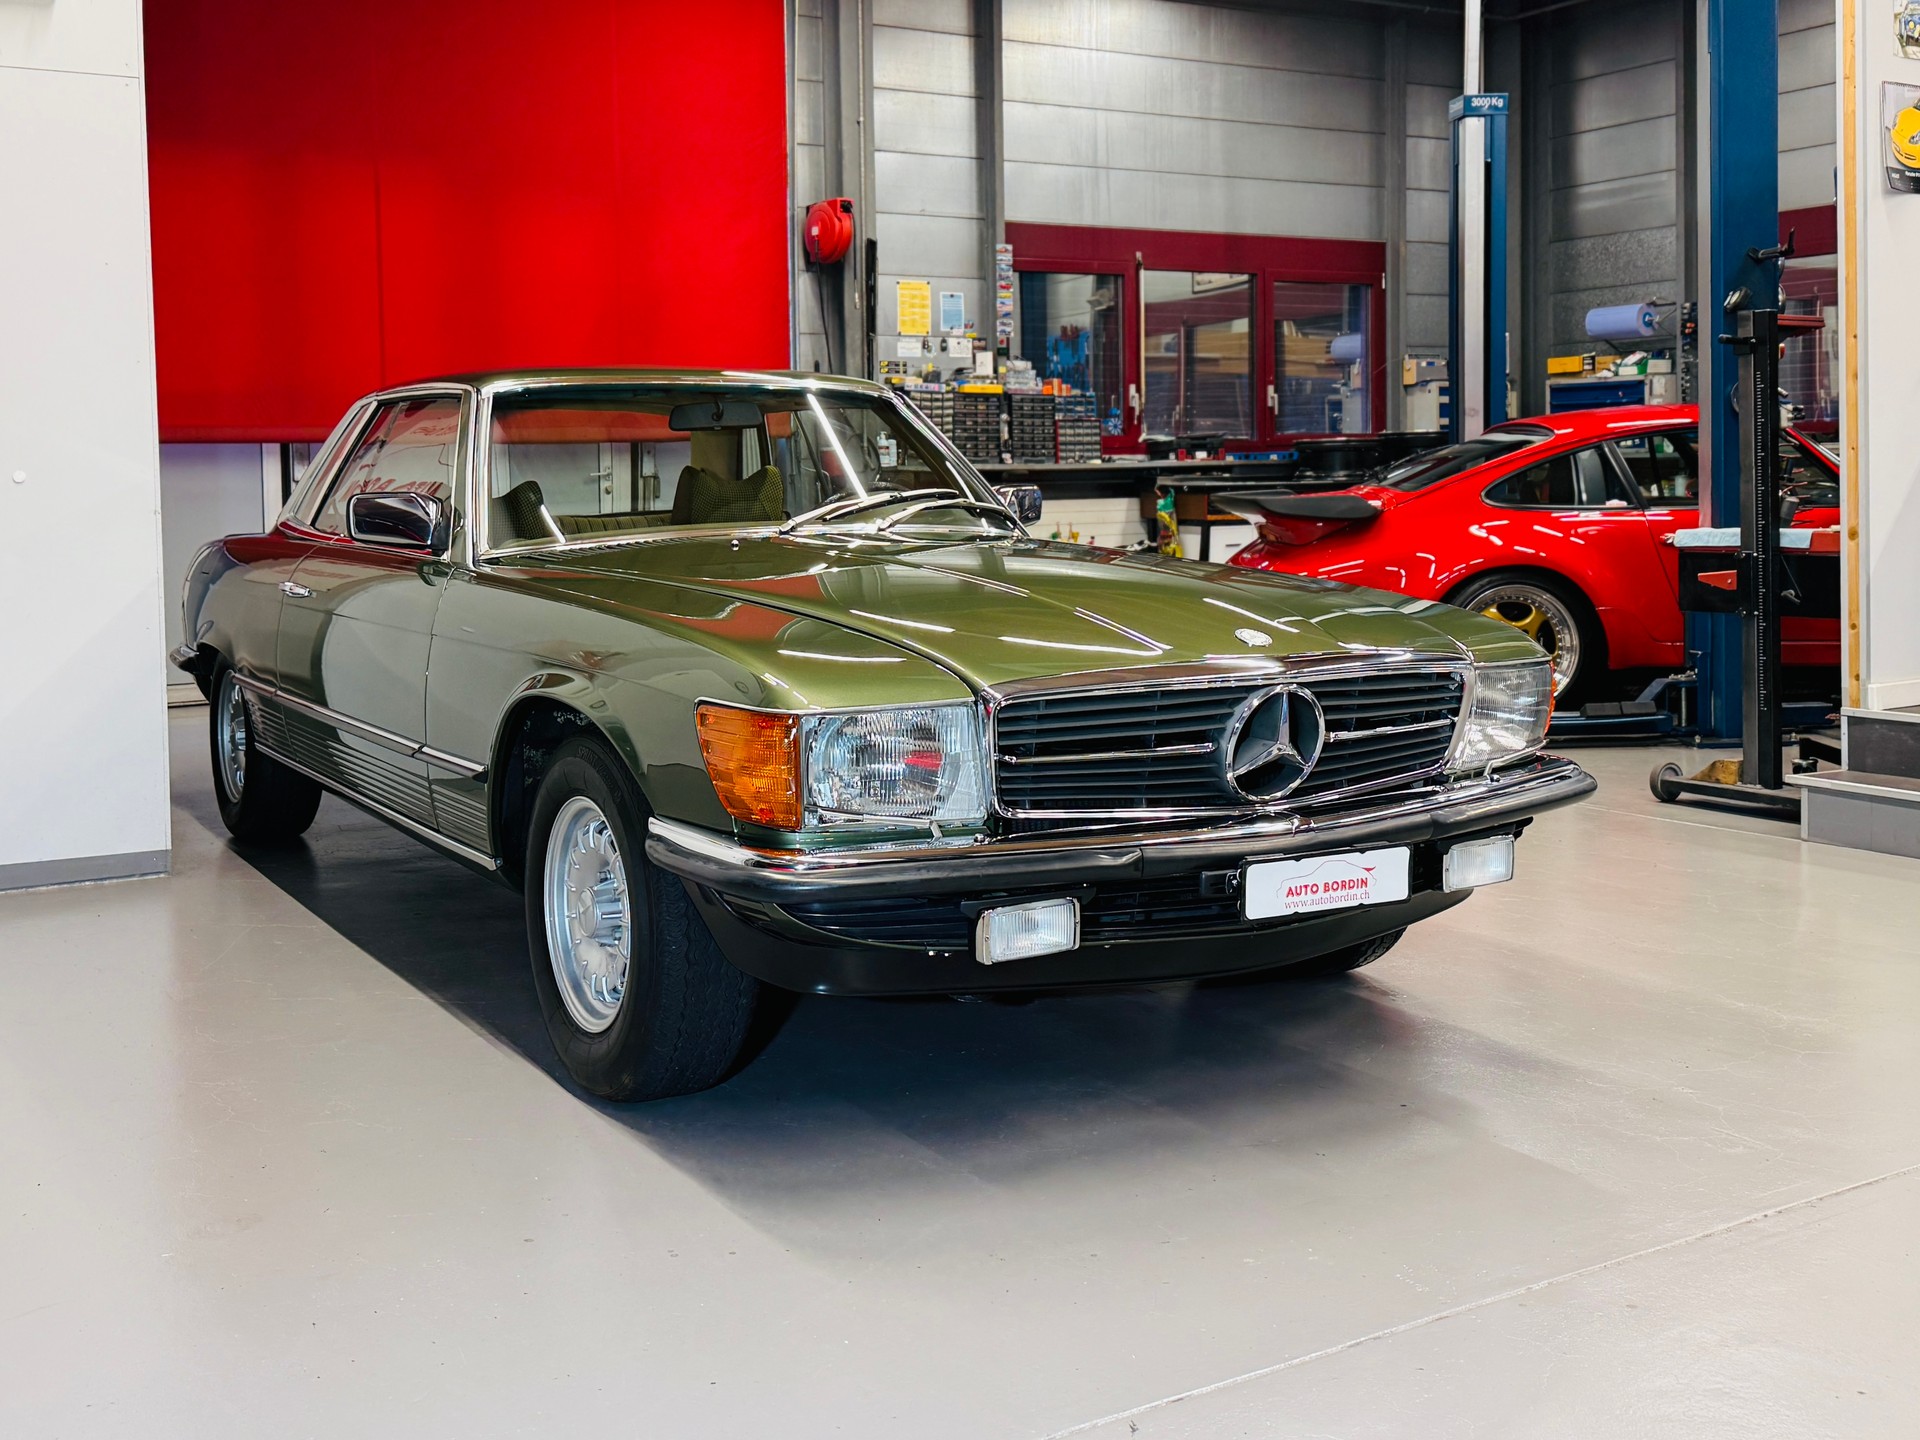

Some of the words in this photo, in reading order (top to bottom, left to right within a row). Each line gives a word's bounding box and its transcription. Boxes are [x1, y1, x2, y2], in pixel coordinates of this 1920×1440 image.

[1471, 97, 1491, 107] 3000
[1491, 96, 1504, 108] Kg
[1286, 883, 1319, 898] AUTO
[1323, 877, 1368, 893] BORDIN
[1284, 889, 1370, 909] www.autobordin.ch
